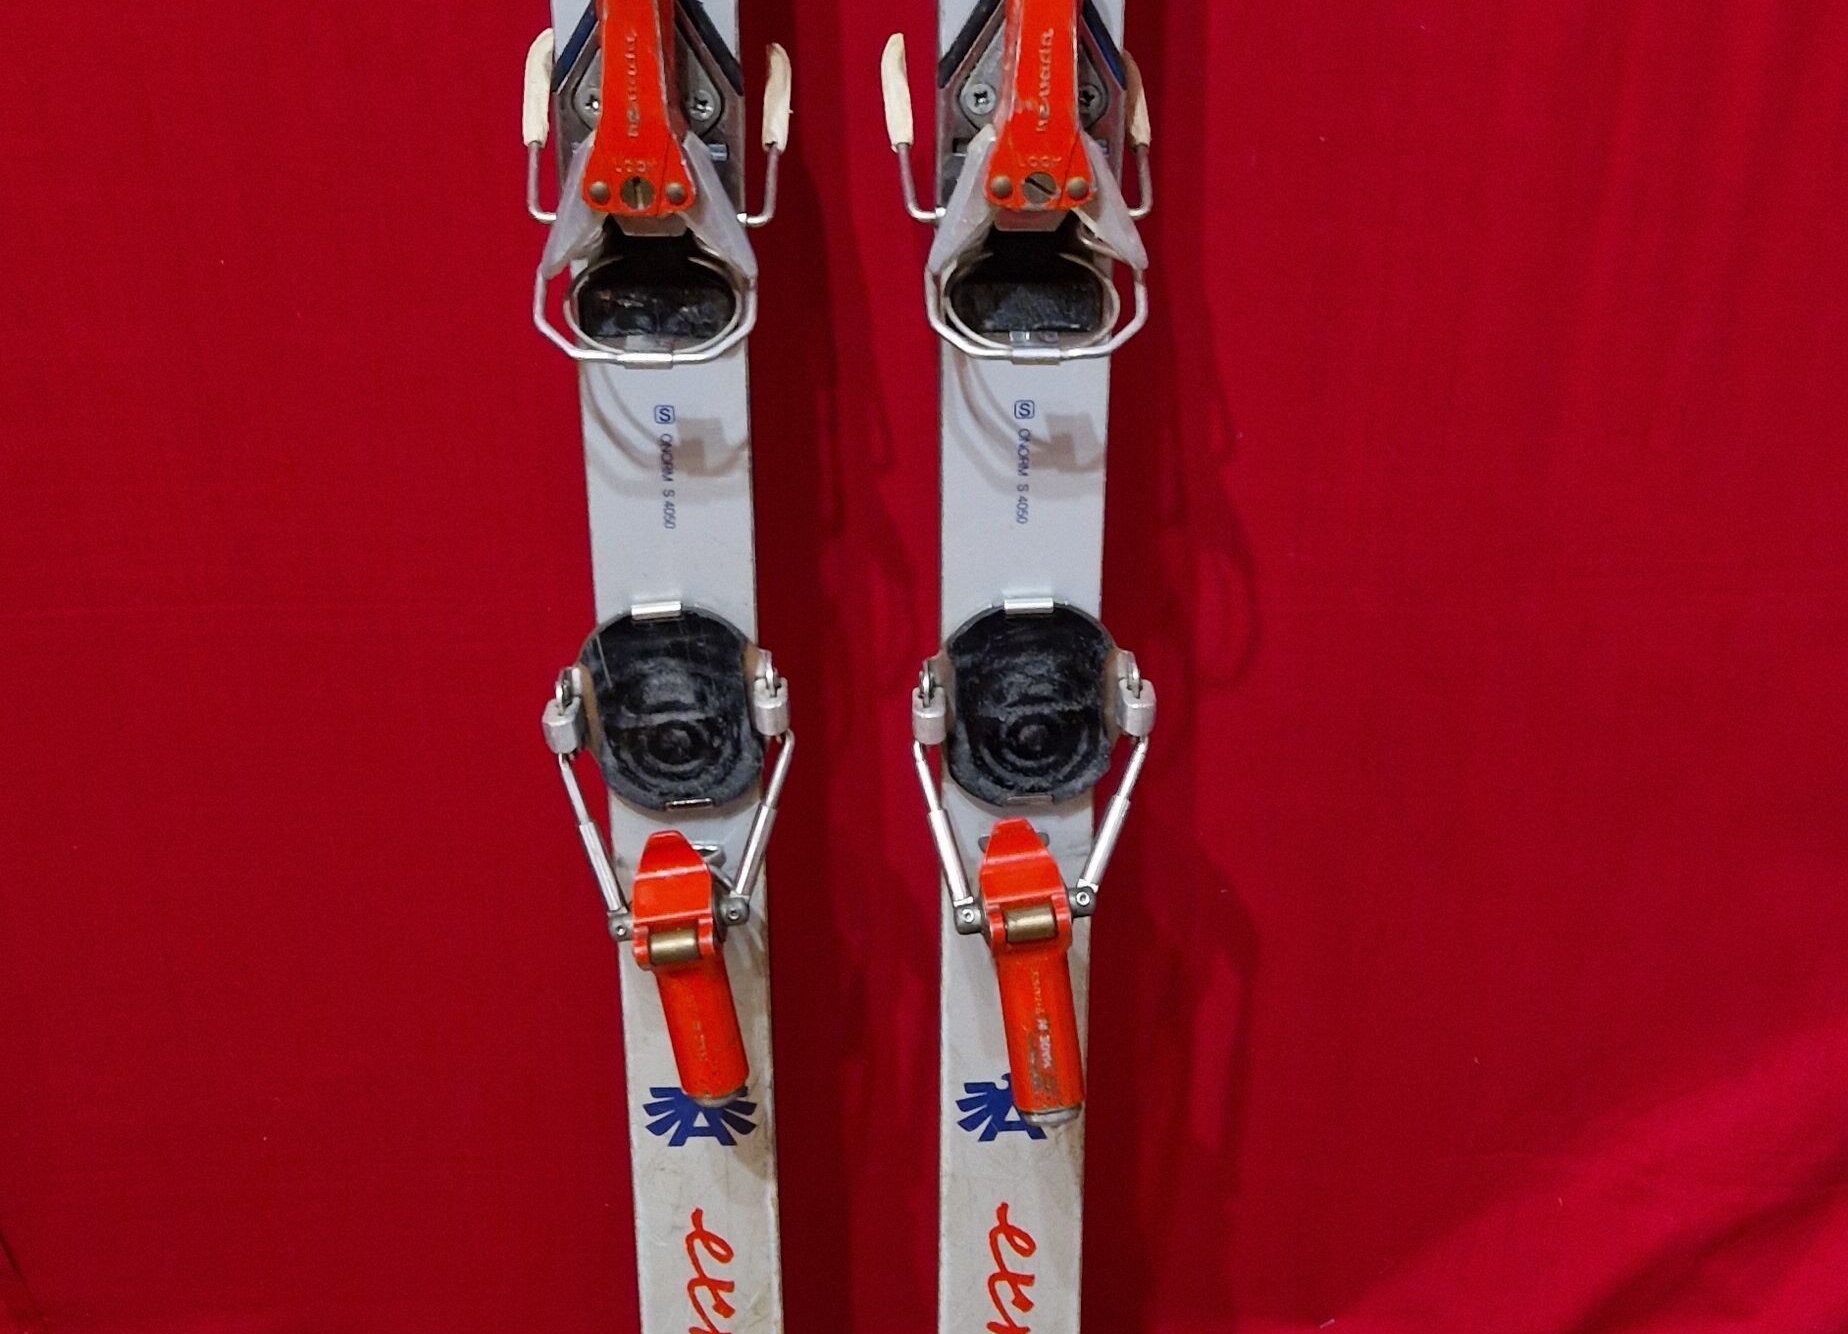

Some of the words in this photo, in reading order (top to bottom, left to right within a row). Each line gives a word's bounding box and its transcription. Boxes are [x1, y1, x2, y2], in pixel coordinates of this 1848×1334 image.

[662, 489, 675, 498] S
[1016, 484, 1030, 492] S
[663, 501, 676, 529] 4050
[1016, 495, 1029, 524] 4050
